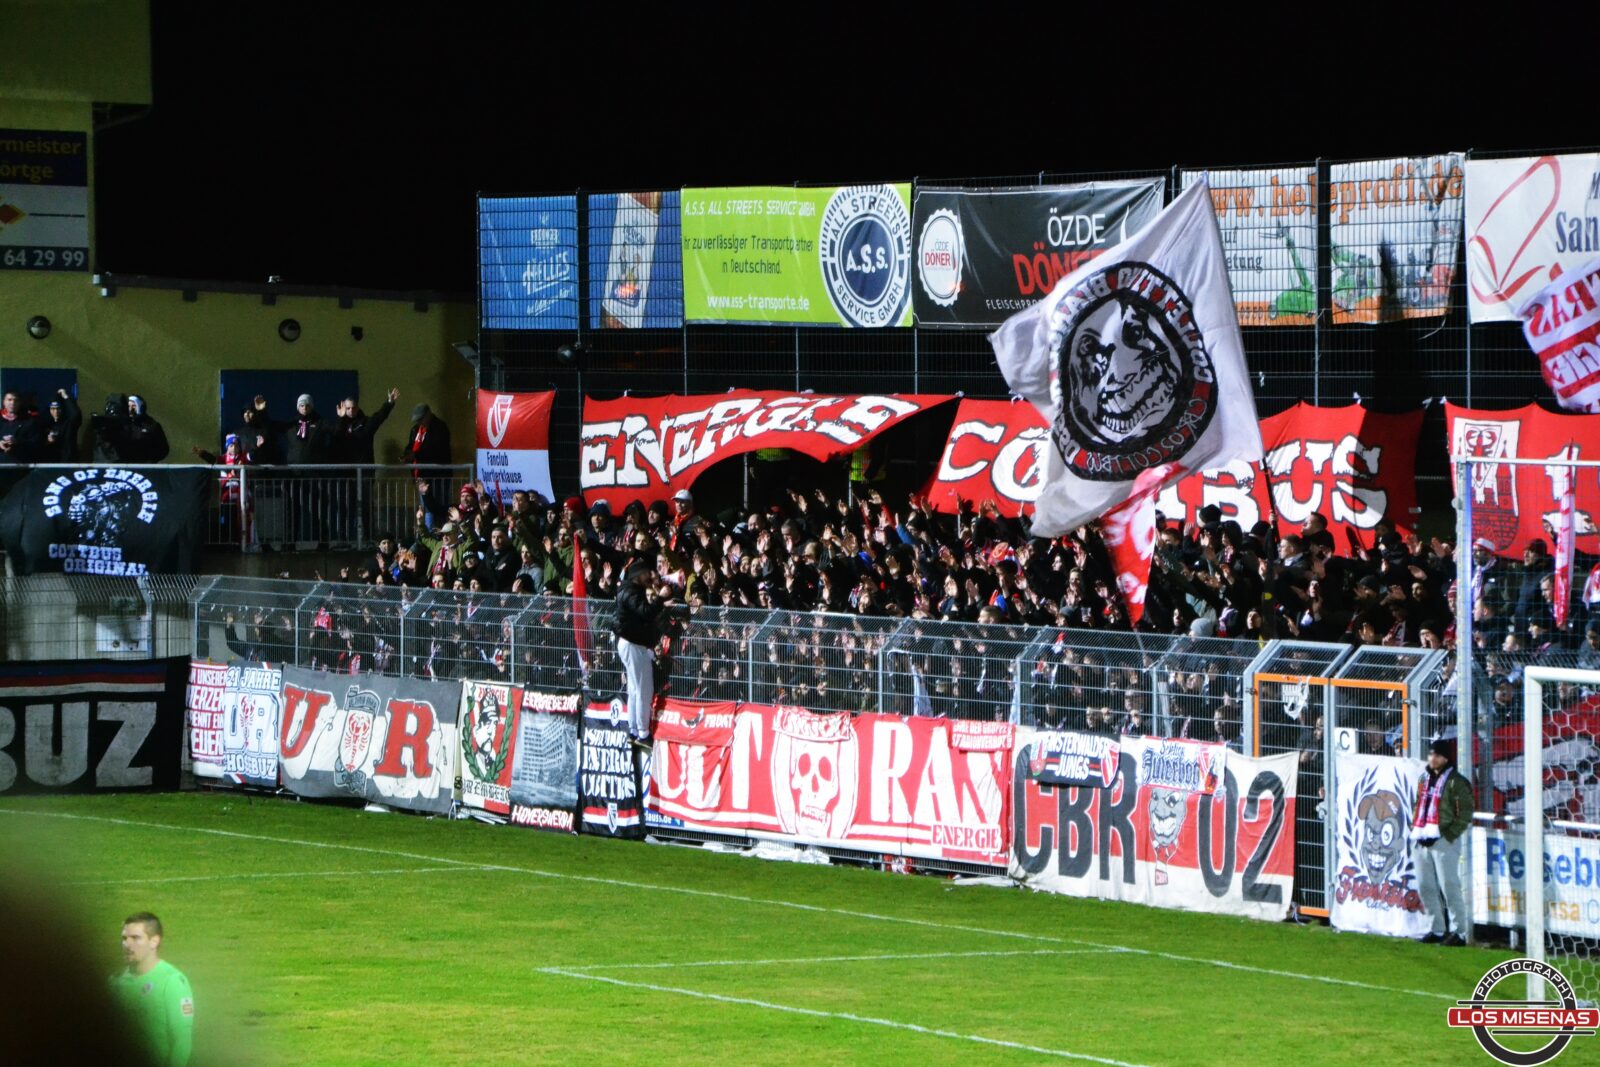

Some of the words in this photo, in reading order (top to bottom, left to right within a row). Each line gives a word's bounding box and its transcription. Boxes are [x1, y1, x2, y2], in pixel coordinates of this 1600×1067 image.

[726, 200, 763, 216] STREETS
[767, 201, 798, 216] SERVICE
[830, 209, 849, 241] ALL
[851, 195, 901, 235] STREETS
[1047, 207, 1106, 247] ÖZDE
[692, 234, 748, 253] zuverlässiger
[4, 250, 26, 266] 64
[33, 250, 55, 266] 29
[62, 251, 84, 267] 99
[846, 244, 889, 274] A.S.S.
[1227, 254, 1264, 274] etung
[836, 284, 876, 324] SERVICE
[878, 282, 903, 321] GMBH
[985, 299, 1043, 310] FLEISCHPRO
[486, 452, 509, 467] Fanclub
[42, 475, 73, 518] SONS
[73, 468, 99, 482] OF
[103, 468, 159, 525] ENERGIE
[48, 543, 122, 560] COTTBUS
[63, 558, 149, 577] ORIGINAL
[227, 667, 240, 687] 21
[241, 668, 282, 691] JAHRE
[375, 699, 434, 779] R
[1338, 730, 1351, 751] C
[1054, 753, 1090, 780] JUNGS
[511, 804, 575, 832] HOYERSWERDA
[932, 824, 999, 849] ENERGIE
